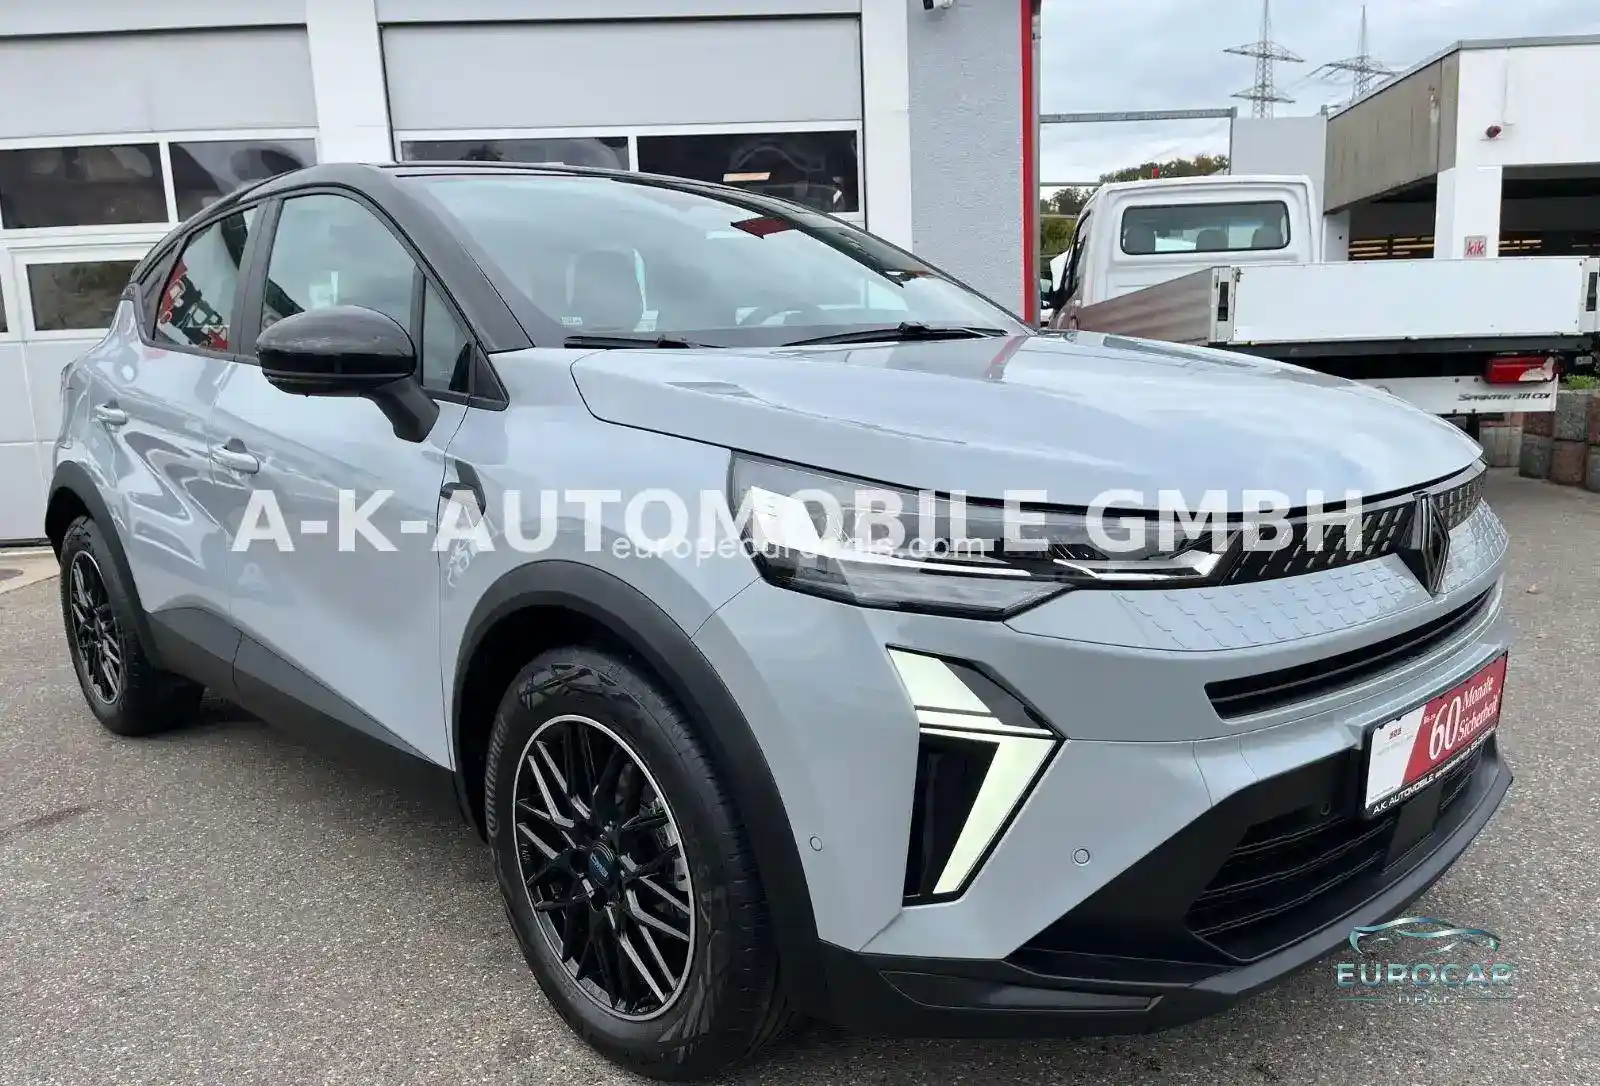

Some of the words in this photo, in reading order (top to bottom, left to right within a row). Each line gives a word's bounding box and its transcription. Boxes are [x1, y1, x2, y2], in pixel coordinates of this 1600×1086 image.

[1466, 240, 1486, 256] kik
[1531, 392, 1552, 401] CDI
[1428, 695, 1462, 761] 60
[1461, 674, 1495, 713] Monate
[1388, 773, 1435, 806] AUTOMOBILE
